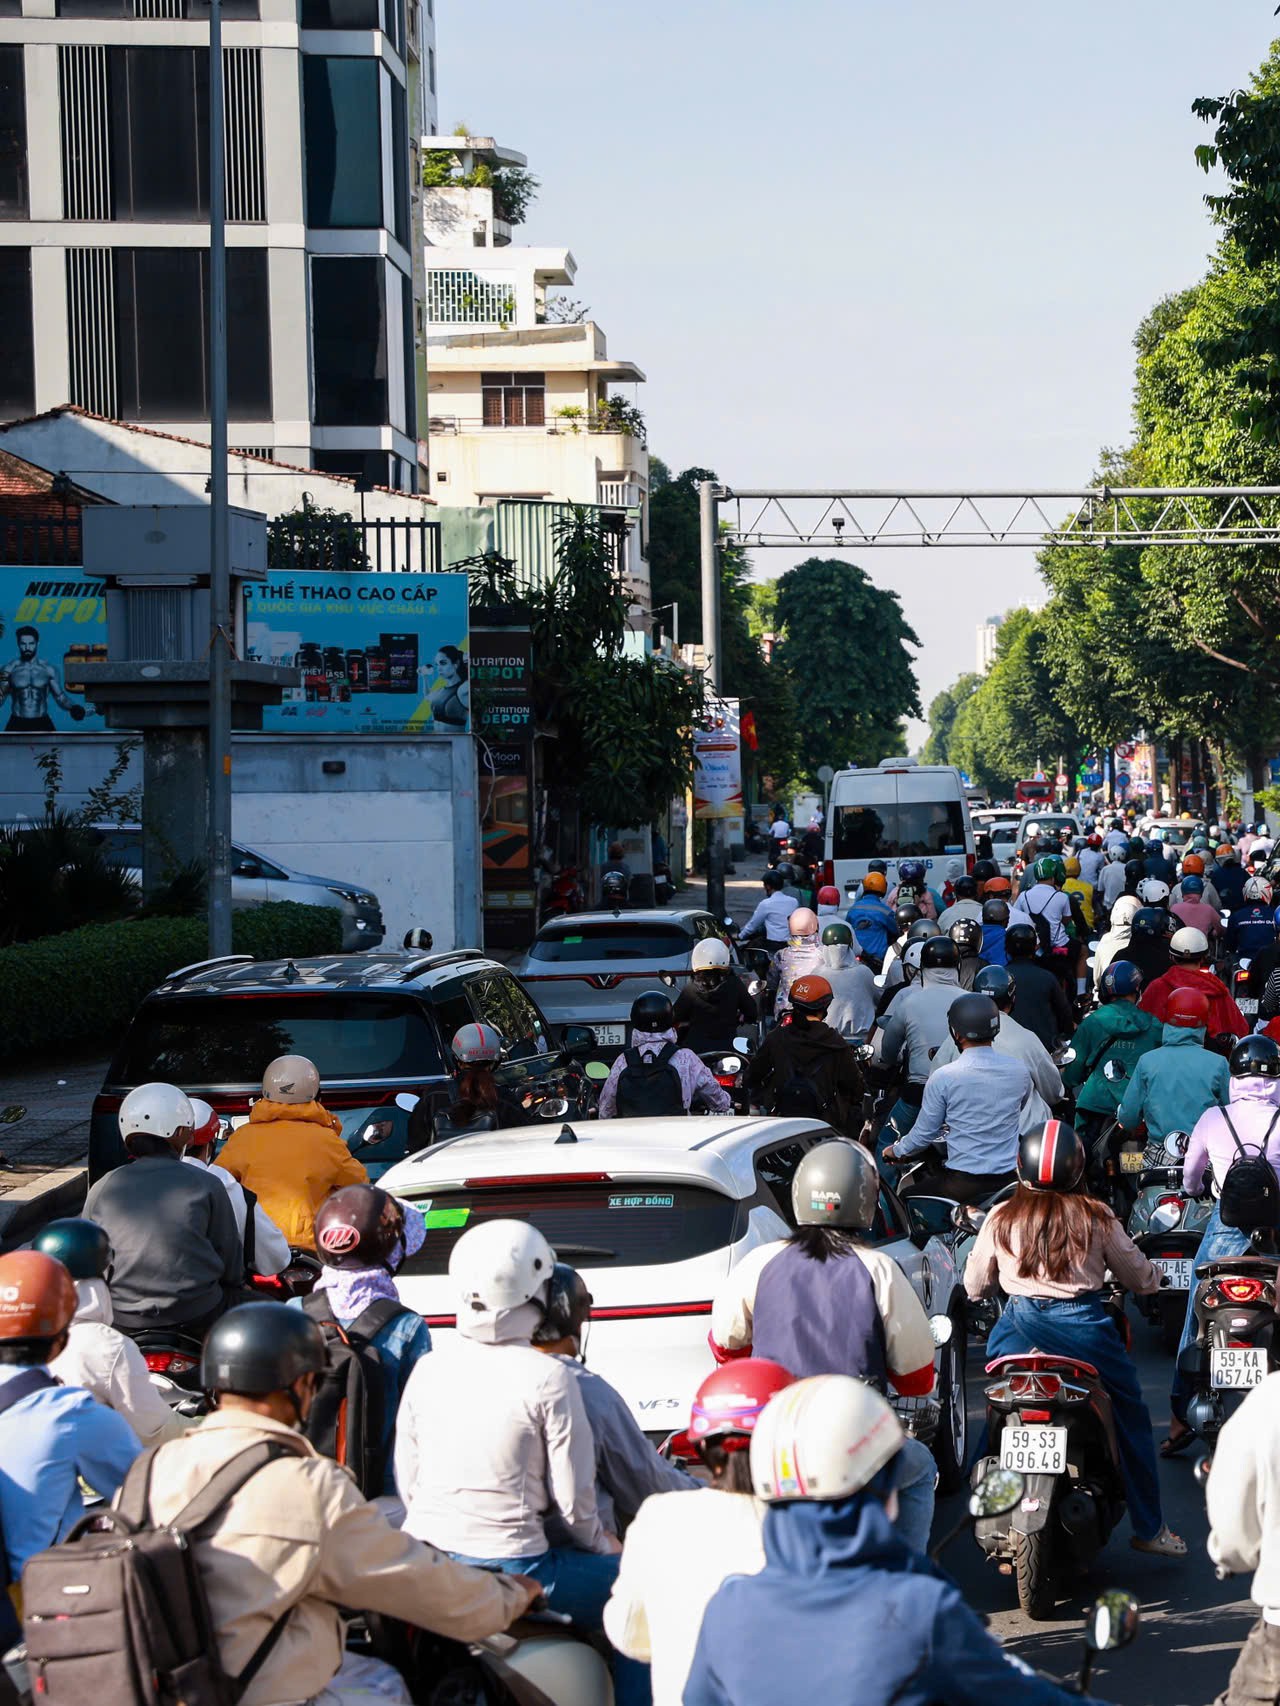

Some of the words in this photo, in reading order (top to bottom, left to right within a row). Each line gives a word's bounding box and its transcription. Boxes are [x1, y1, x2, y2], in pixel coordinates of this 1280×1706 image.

[300, 586, 350, 600] THAO
[357, 588, 396, 600] CAO
[402, 583, 438, 601] CẤP
[471, 657, 525, 666] UTRITION
[487, 706, 530, 714] UTRITION
[609, 1197, 621, 1206] XE
[1220, 1352, 1259, 1367] 59-KA
[1216, 1370, 1262, 1385] 057.46
[1012, 1431, 1056, 1448] 59-S3
[1005, 1452, 1061, 1469] 096.48
